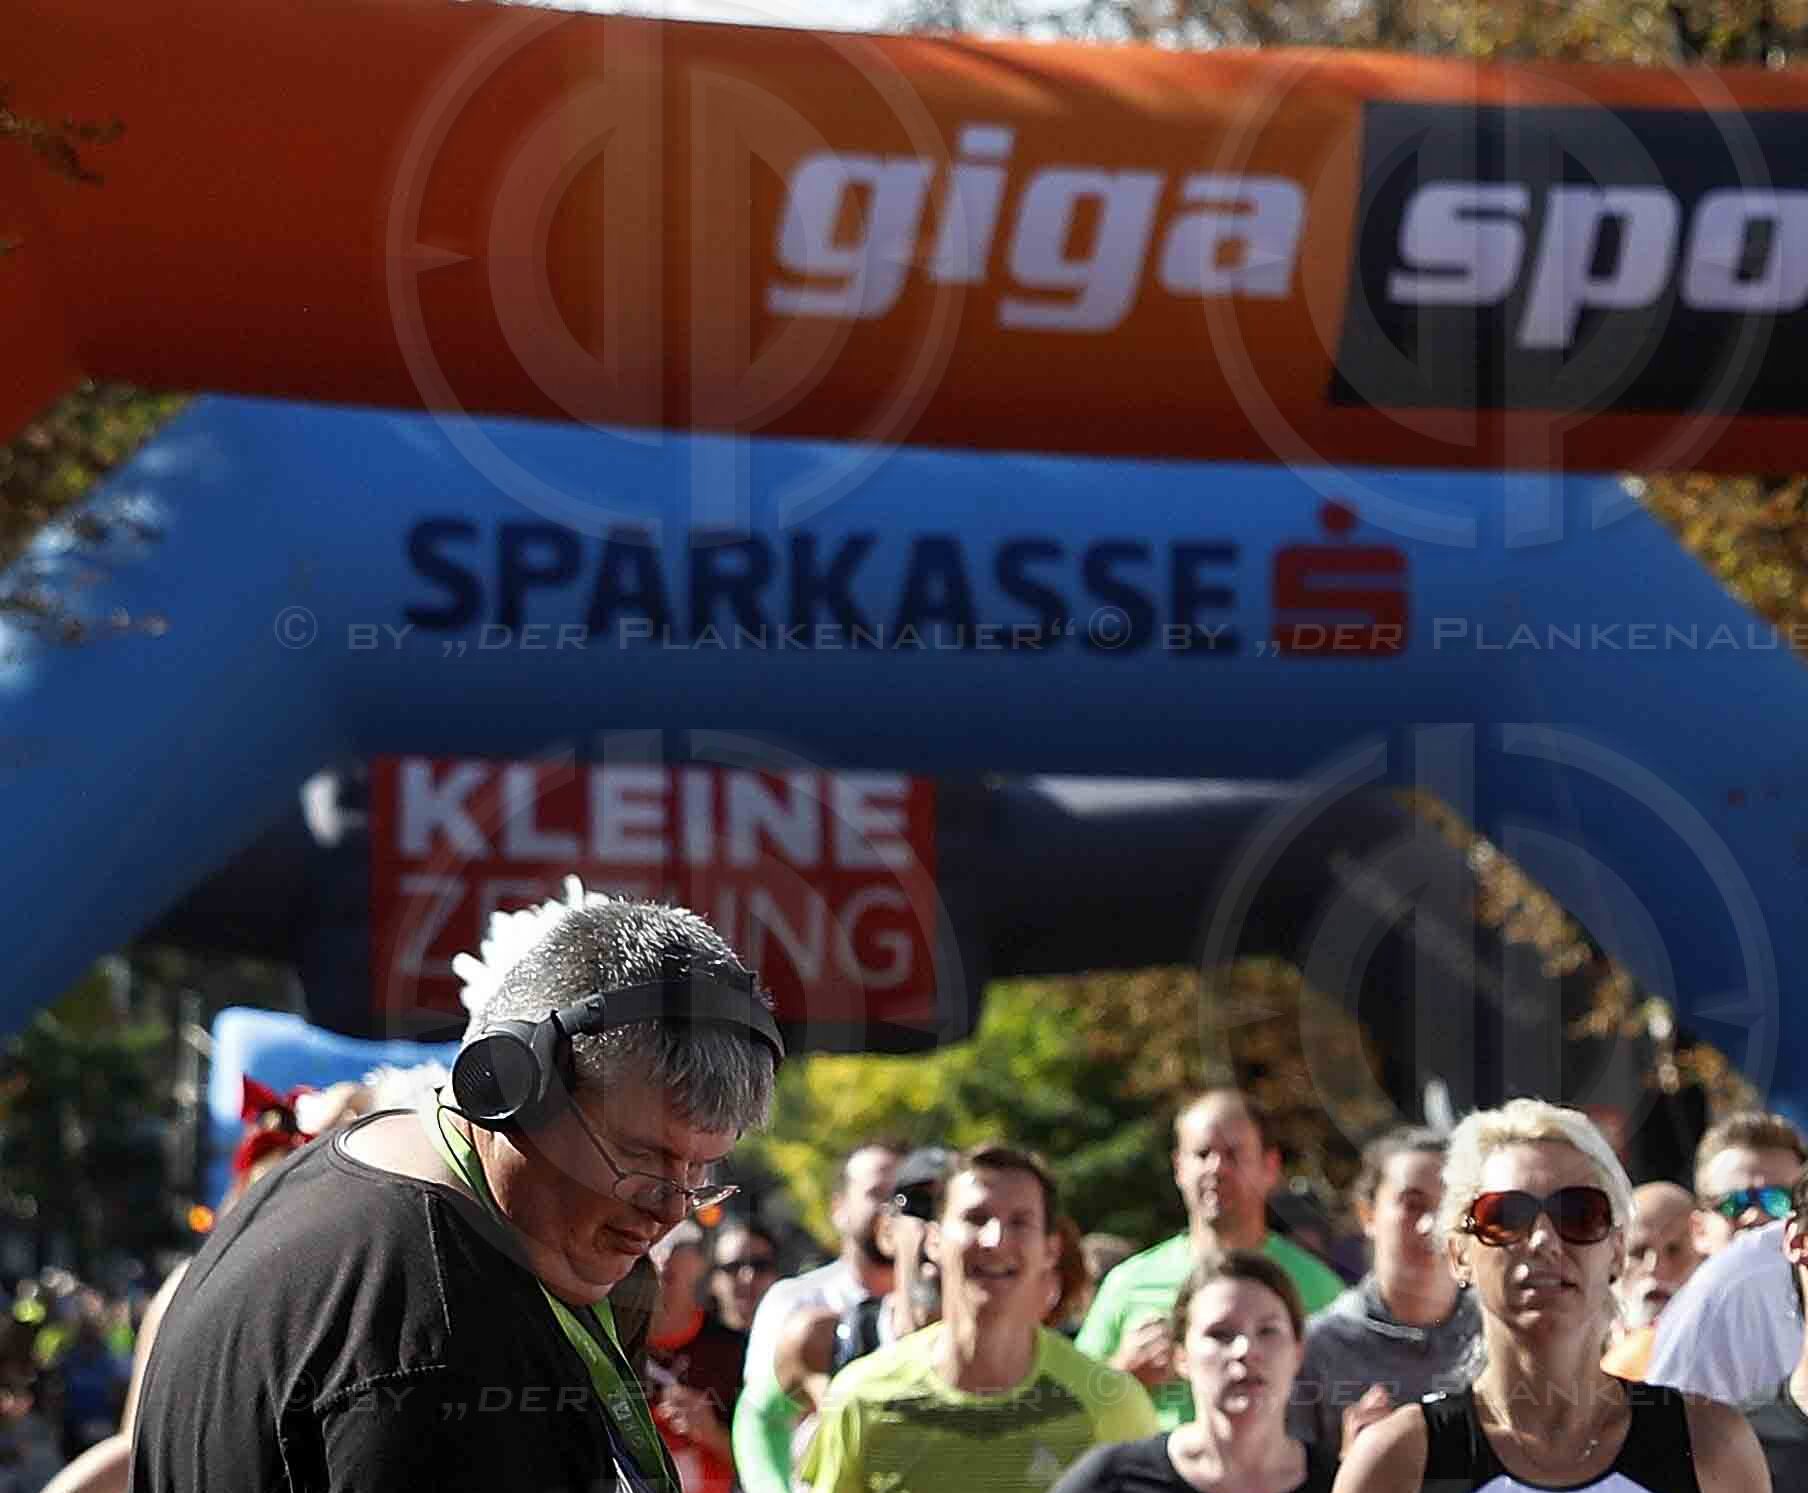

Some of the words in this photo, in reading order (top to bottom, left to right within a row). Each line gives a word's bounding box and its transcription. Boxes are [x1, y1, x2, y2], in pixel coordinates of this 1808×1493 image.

[766, 126, 1307, 332] giga
[405, 514, 1240, 659] SPARKASSE
[396, 757, 914, 870] KLEINE
